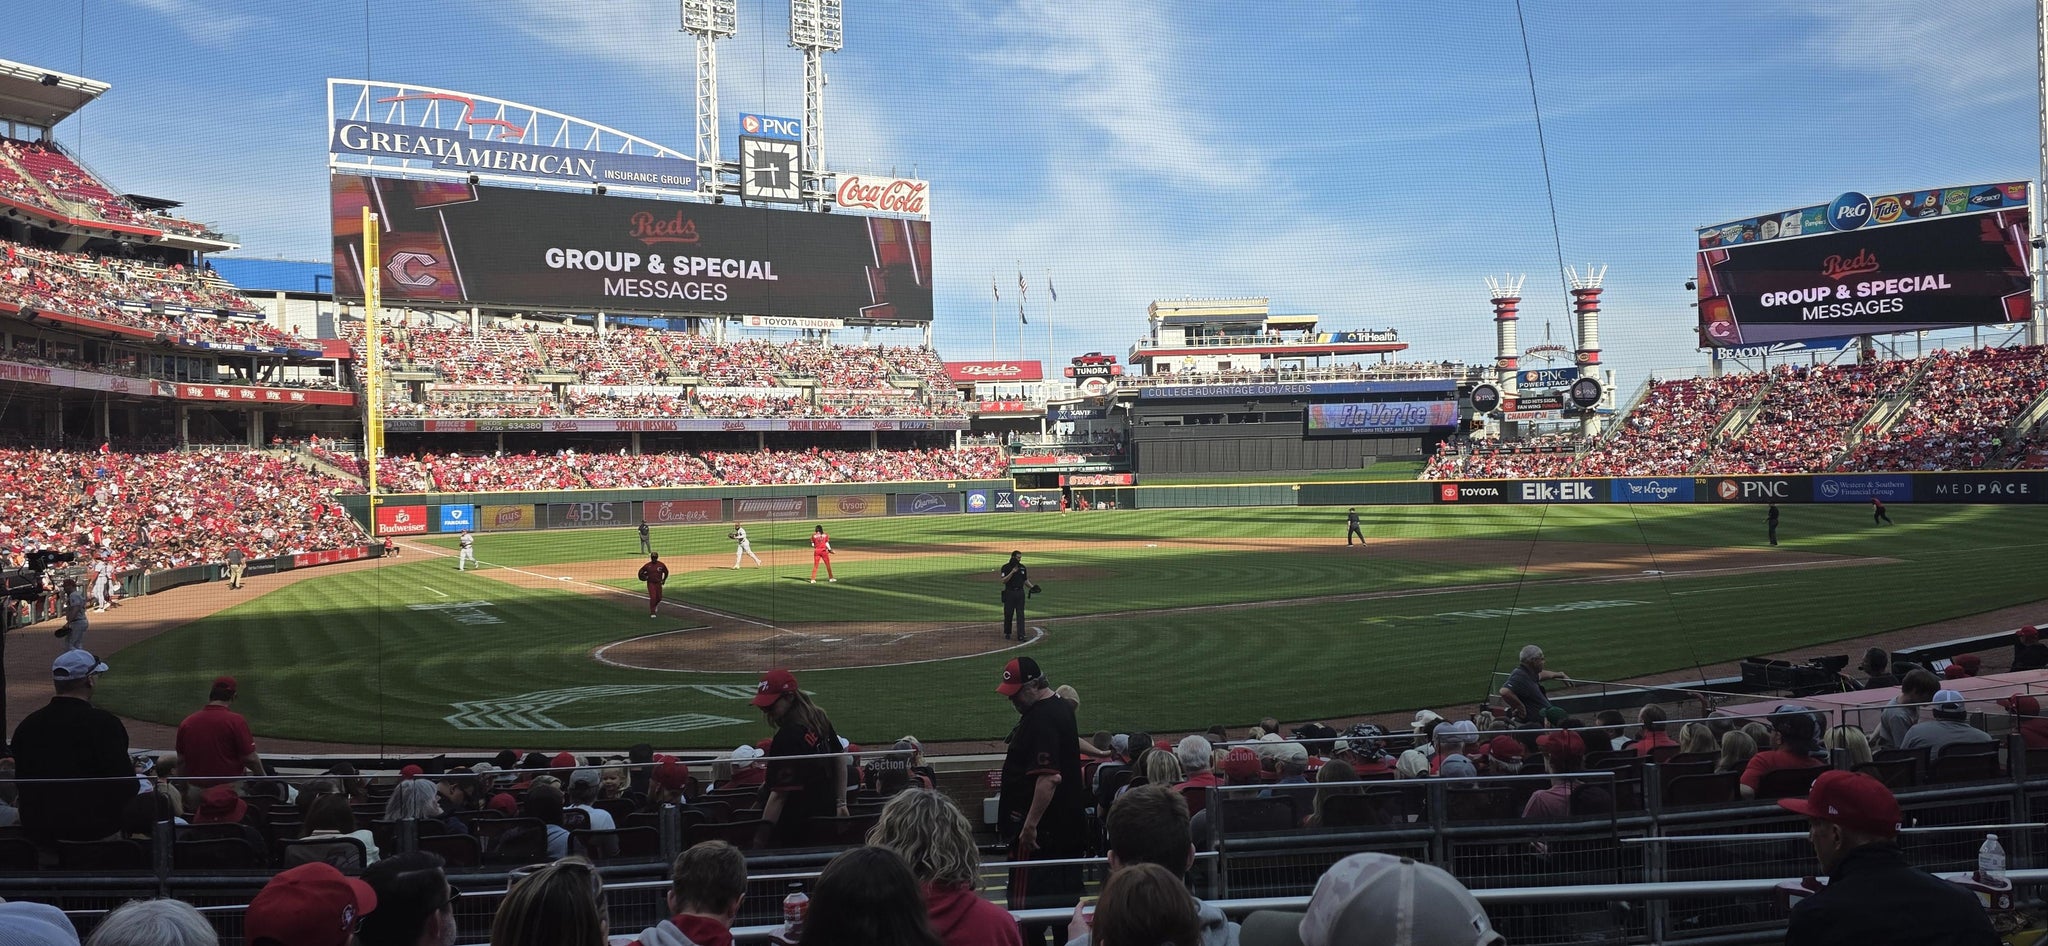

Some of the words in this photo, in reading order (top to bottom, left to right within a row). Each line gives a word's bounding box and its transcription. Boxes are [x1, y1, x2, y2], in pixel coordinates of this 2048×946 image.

[762, 118, 799, 137] PNC
[604, 169, 658, 183] INSURANCE
[661, 174, 692, 186] GROUP
[1837, 203, 1867, 219] P&G
[1874, 202, 1899, 219] Tide
[629, 210, 699, 245] Reds
[545, 248, 641, 272] GROUP
[647, 254, 666, 274] &
[673, 256, 778, 280] SPECIAL
[1822, 248, 1880, 280] Reds
[604, 277, 727, 301] MESSAGES
[1760, 286, 1831, 307] GROUP
[1836, 284, 1851, 300] &
[1857, 273, 1952, 297] SPECIAL
[1802, 297, 1904, 321] MESSAGES
[763, 317, 798, 327] TOYOTA
[799, 318, 835, 328] TUNDRA
[1357, 332, 1396, 342] TriHealth
[1717, 345, 1768, 360] BEACON
[960, 364, 1022, 376] Reds
[1077, 366, 1109, 375] TUNDRA
[1540, 370, 1567, 381] PNC
[110, 378, 129, 391] Reds
[1519, 381, 1545, 389] POWER
[1583, 388, 1597, 396] PNC
[508, 422, 541, 430] $34,380
[551, 421, 578, 431] Reds
[616, 420, 642, 431] SPECIAL
[643, 420, 678, 431] MESSAGES
[722, 421, 745, 430] Reds
[788, 420, 811, 430] SPECIAL
[811, 420, 842, 430] MESSAGES
[872, 421, 893, 430] Reds
[1644, 481, 1678, 499] Kroger
[1743, 481, 1788, 497] PNC
[1840, 482, 1864, 490] Western
[1876, 481, 1904, 489] Southern
[1461, 488, 1499, 496] TOYOTA
[1873, 487, 1895, 496] Group
[842, 501, 865, 510] Tyson
[379, 523, 425, 533] Budweiser
[1218, 752, 1254, 762] Section
[868, 760, 903, 771] Section
